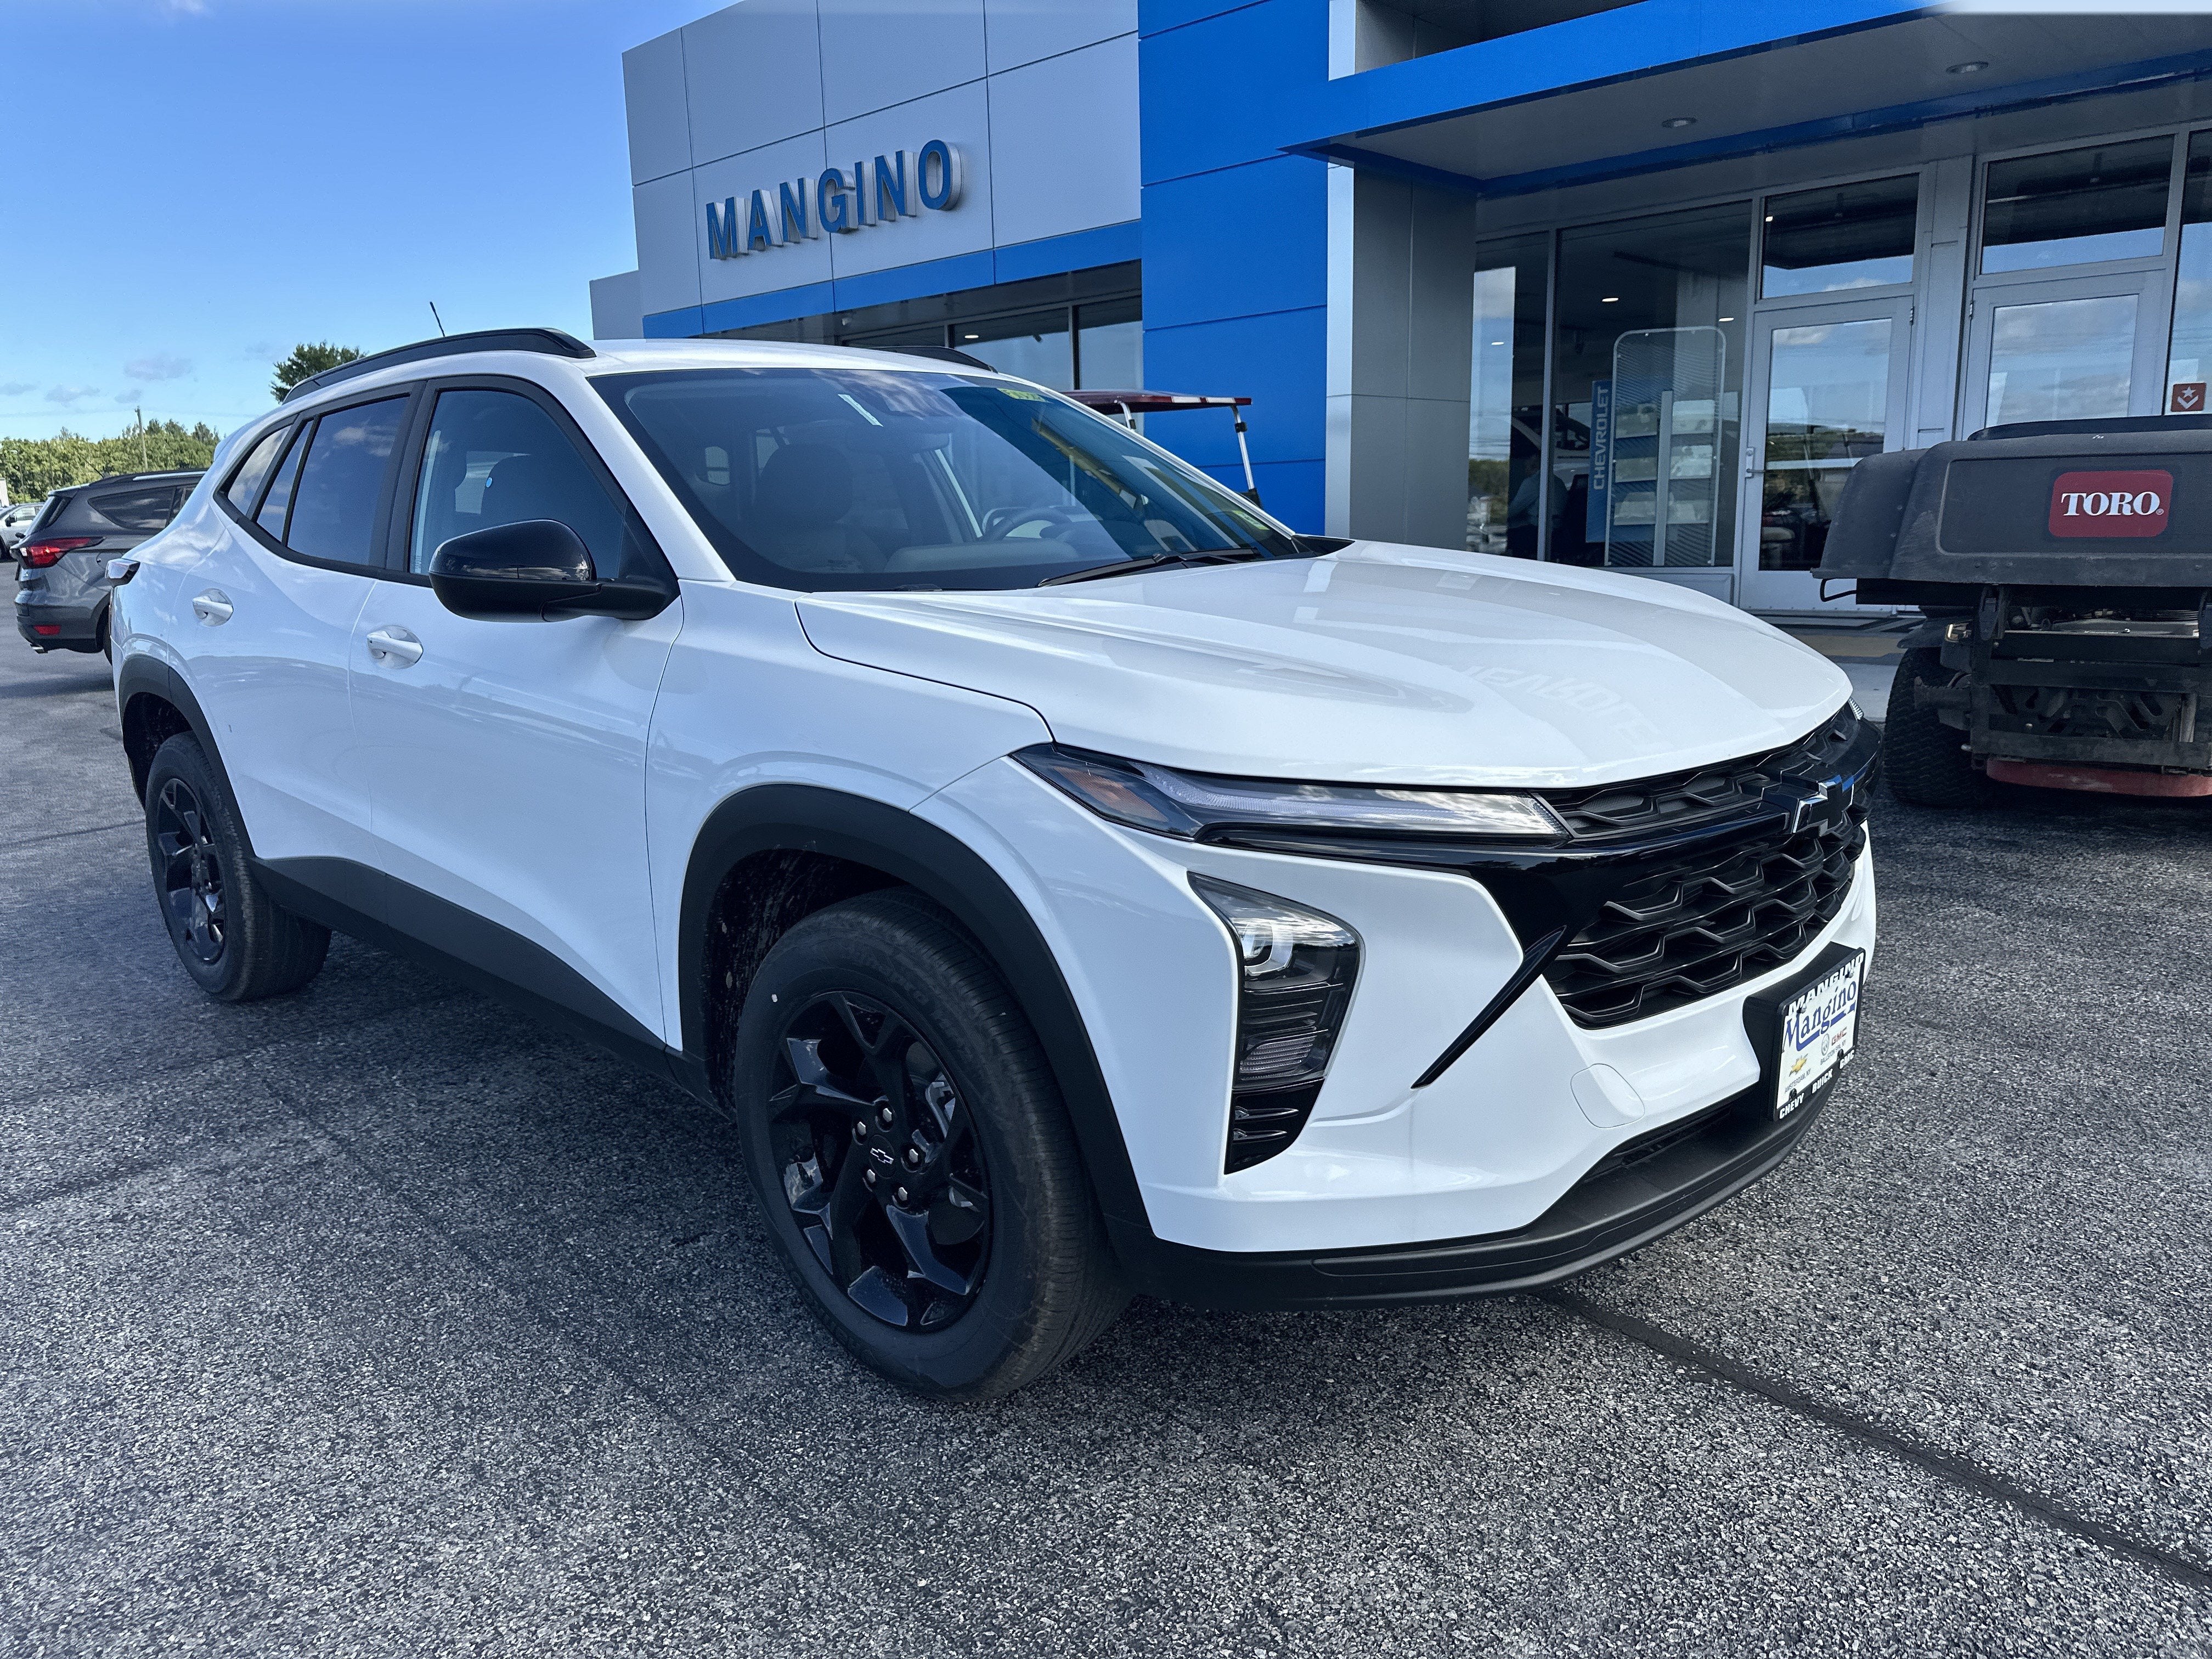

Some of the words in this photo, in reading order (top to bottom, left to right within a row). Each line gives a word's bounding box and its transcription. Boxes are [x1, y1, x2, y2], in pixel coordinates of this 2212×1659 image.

[706, 139, 962, 260] MANGINO
[1593, 386, 1609, 490] CHEVROLET
[2061, 491, 2160, 516] TORO
[1782, 981, 1857, 1052] Mangino
[1788, 952, 1864, 1015] MANGINO
[1831, 1026, 1847, 1046] GMC
[1779, 1092, 1804, 1119] CHEVY
[1812, 1068, 1833, 1094] BUICK
[1839, 1049, 1855, 1069] GMC
